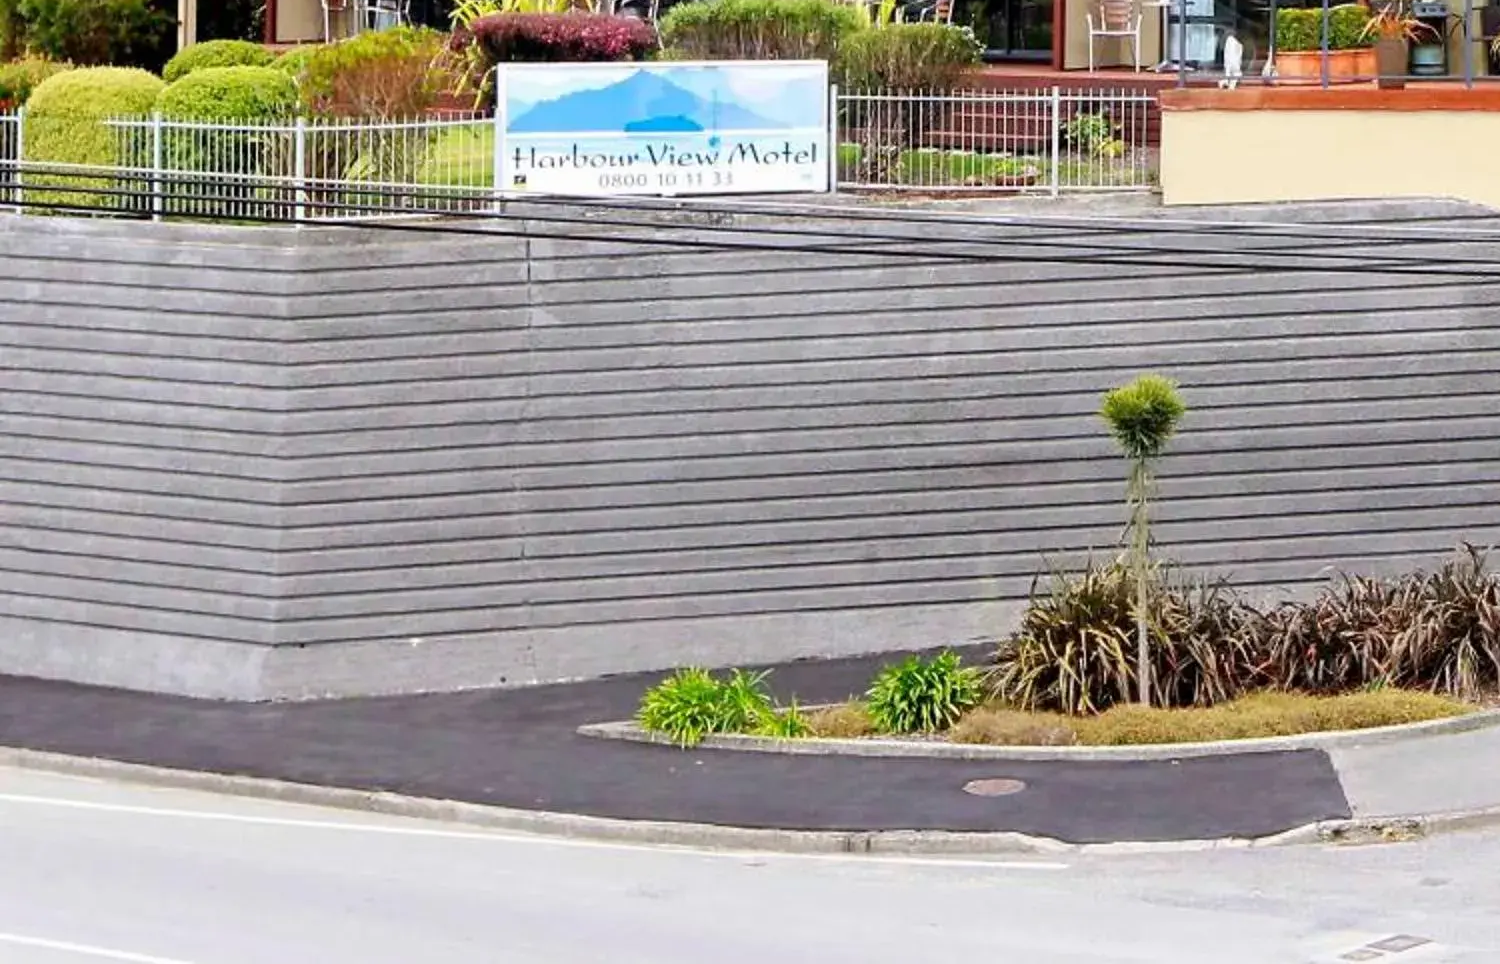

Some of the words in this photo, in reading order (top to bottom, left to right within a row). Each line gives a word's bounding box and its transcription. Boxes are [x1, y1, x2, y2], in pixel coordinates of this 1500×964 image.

[512, 142, 640, 170] Harbour
[645, 142, 720, 167] View
[727, 141, 817, 165] Motel
[598, 173, 648, 188] 0800
[657, 173, 677, 187] 10
